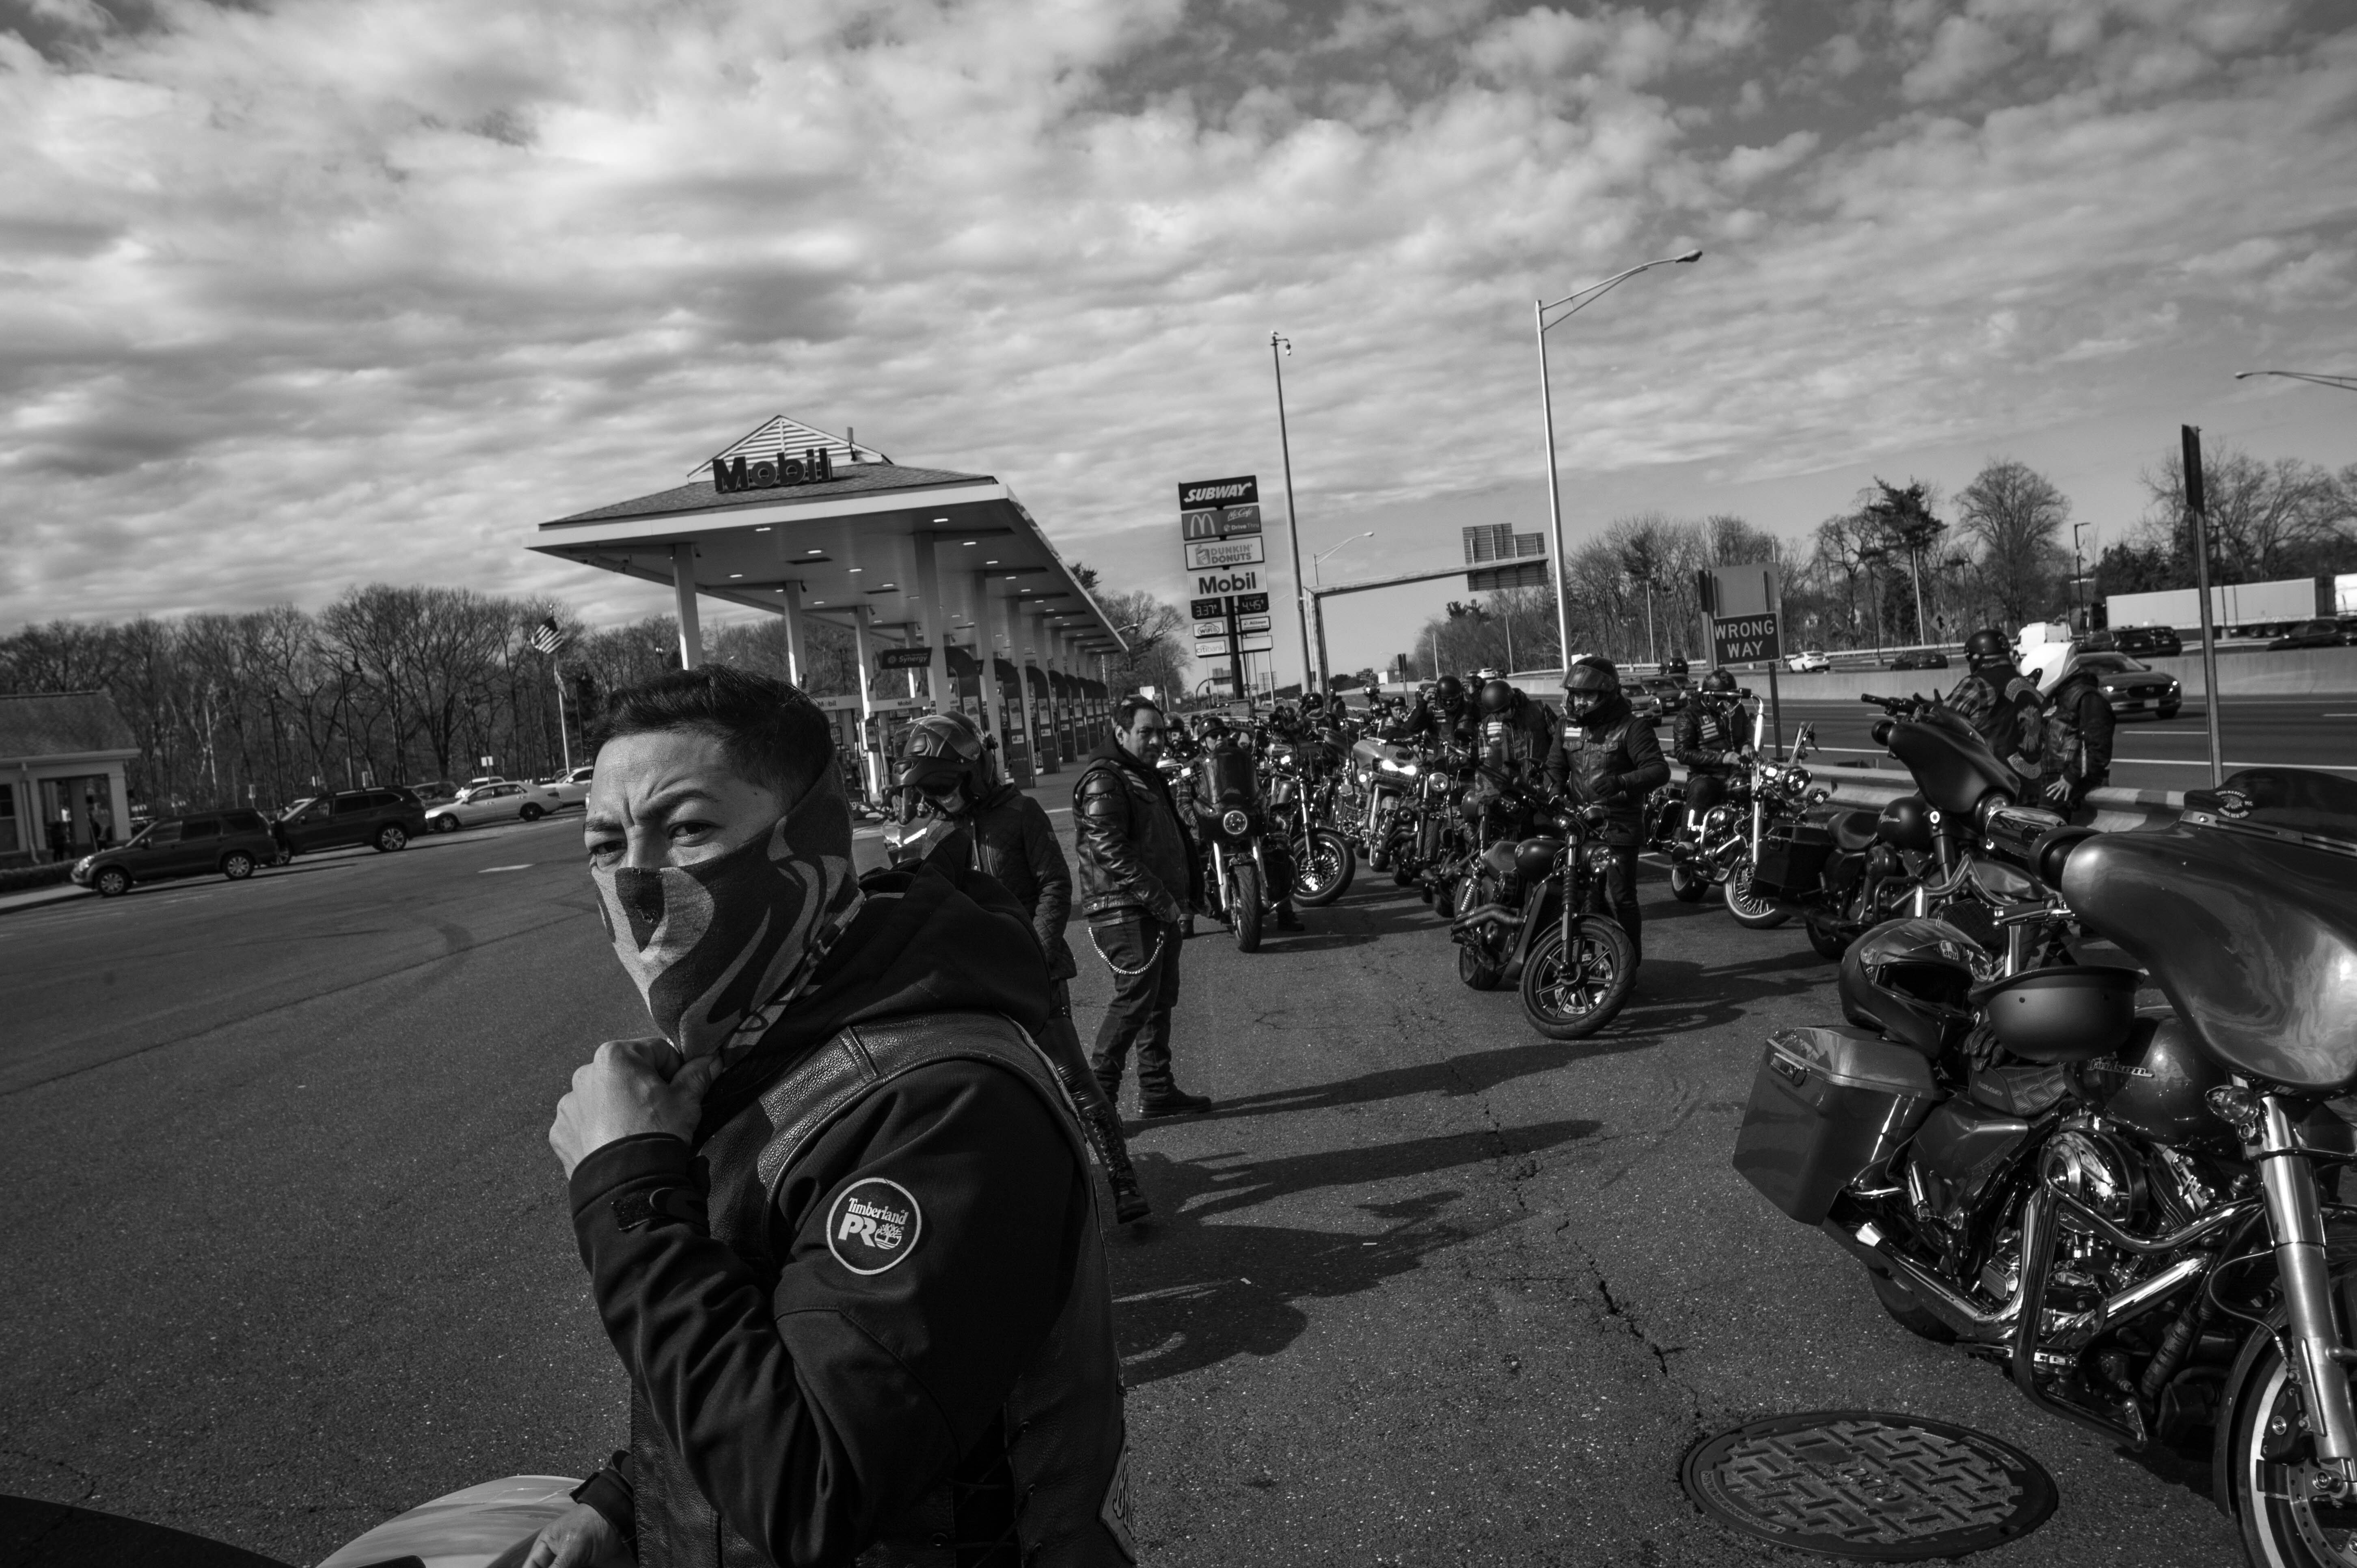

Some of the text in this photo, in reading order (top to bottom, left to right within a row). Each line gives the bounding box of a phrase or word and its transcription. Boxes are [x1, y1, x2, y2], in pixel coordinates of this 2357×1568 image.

[712, 448, 831, 492] Mobil
[1184, 482, 1252, 503] SUBWAY
[1211, 544, 1252, 555] DUNKIN'
[1211, 552, 1252, 564] DONUTS
[1198, 572, 1256, 595] Mobil
[1715, 620, 1774, 640] WRONG
[1196, 645, 1224, 653] citibank
[1727, 641, 1763, 658] WAY
[899, 656, 928, 664] Synergy
[1944, 950, 1958, 959] agv
[848, 1197, 909, 1225] Timberland
